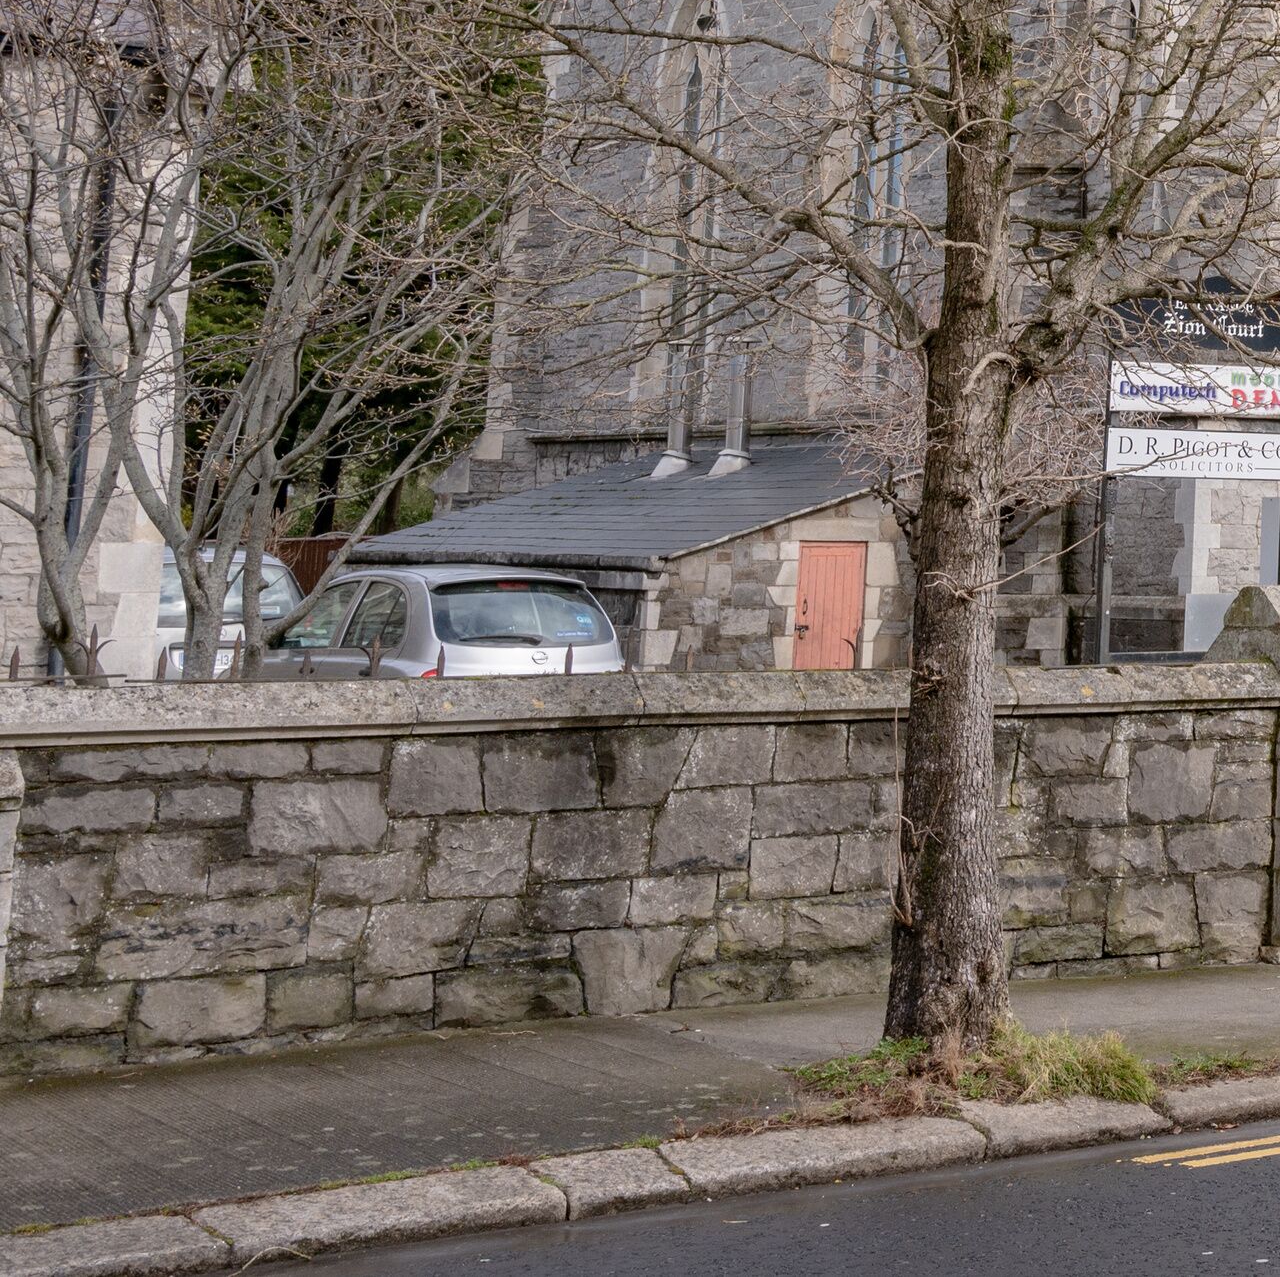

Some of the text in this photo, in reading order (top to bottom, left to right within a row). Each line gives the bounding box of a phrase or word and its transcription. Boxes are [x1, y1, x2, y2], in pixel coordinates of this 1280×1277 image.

[1164, 312, 1207, 336] Zion
[1119, 380, 1217, 402] Computech
[1119, 436, 1137, 454] D.
[1146, 437, 1165, 456] R.
[1173, 438, 1232, 458] PIGOT
[1238, 440, 1254, 458] &
[1160, 461, 1253, 473] SOLICITORS
